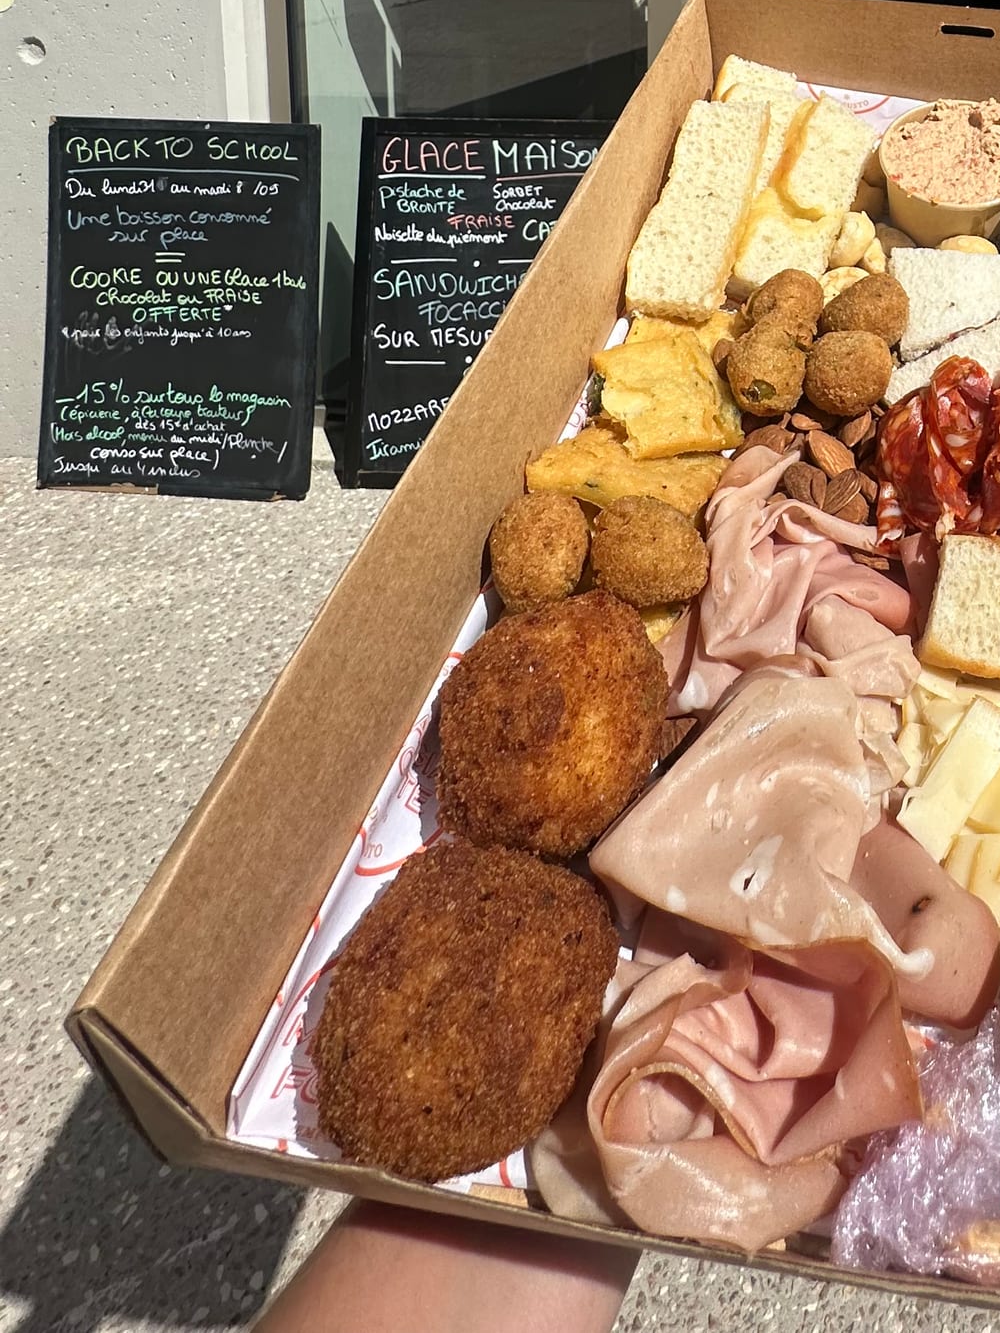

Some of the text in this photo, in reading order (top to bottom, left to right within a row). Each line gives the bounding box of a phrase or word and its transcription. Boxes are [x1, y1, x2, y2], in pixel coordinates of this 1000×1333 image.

[66, 136, 299, 163] BACK TO SCHOOL
[382, 137, 485, 173] GLACE
[65, 178, 96, 199] Du
[170, 183, 192, 194] au
[448, 183, 468, 201] de
[67, 209, 112, 230] Une
[116, 204, 187, 226] boisson
[396, 199, 456, 215] BRONTE
[108, 227, 209, 249] sur place
[374, 222, 425, 243] Noisette
[70, 265, 143, 289] COOKIE
[155, 270, 179, 286] OU
[183, 269, 223, 286] UNE
[373, 323, 420, 349] SUR
[365, 437, 424, 461] Tirami
